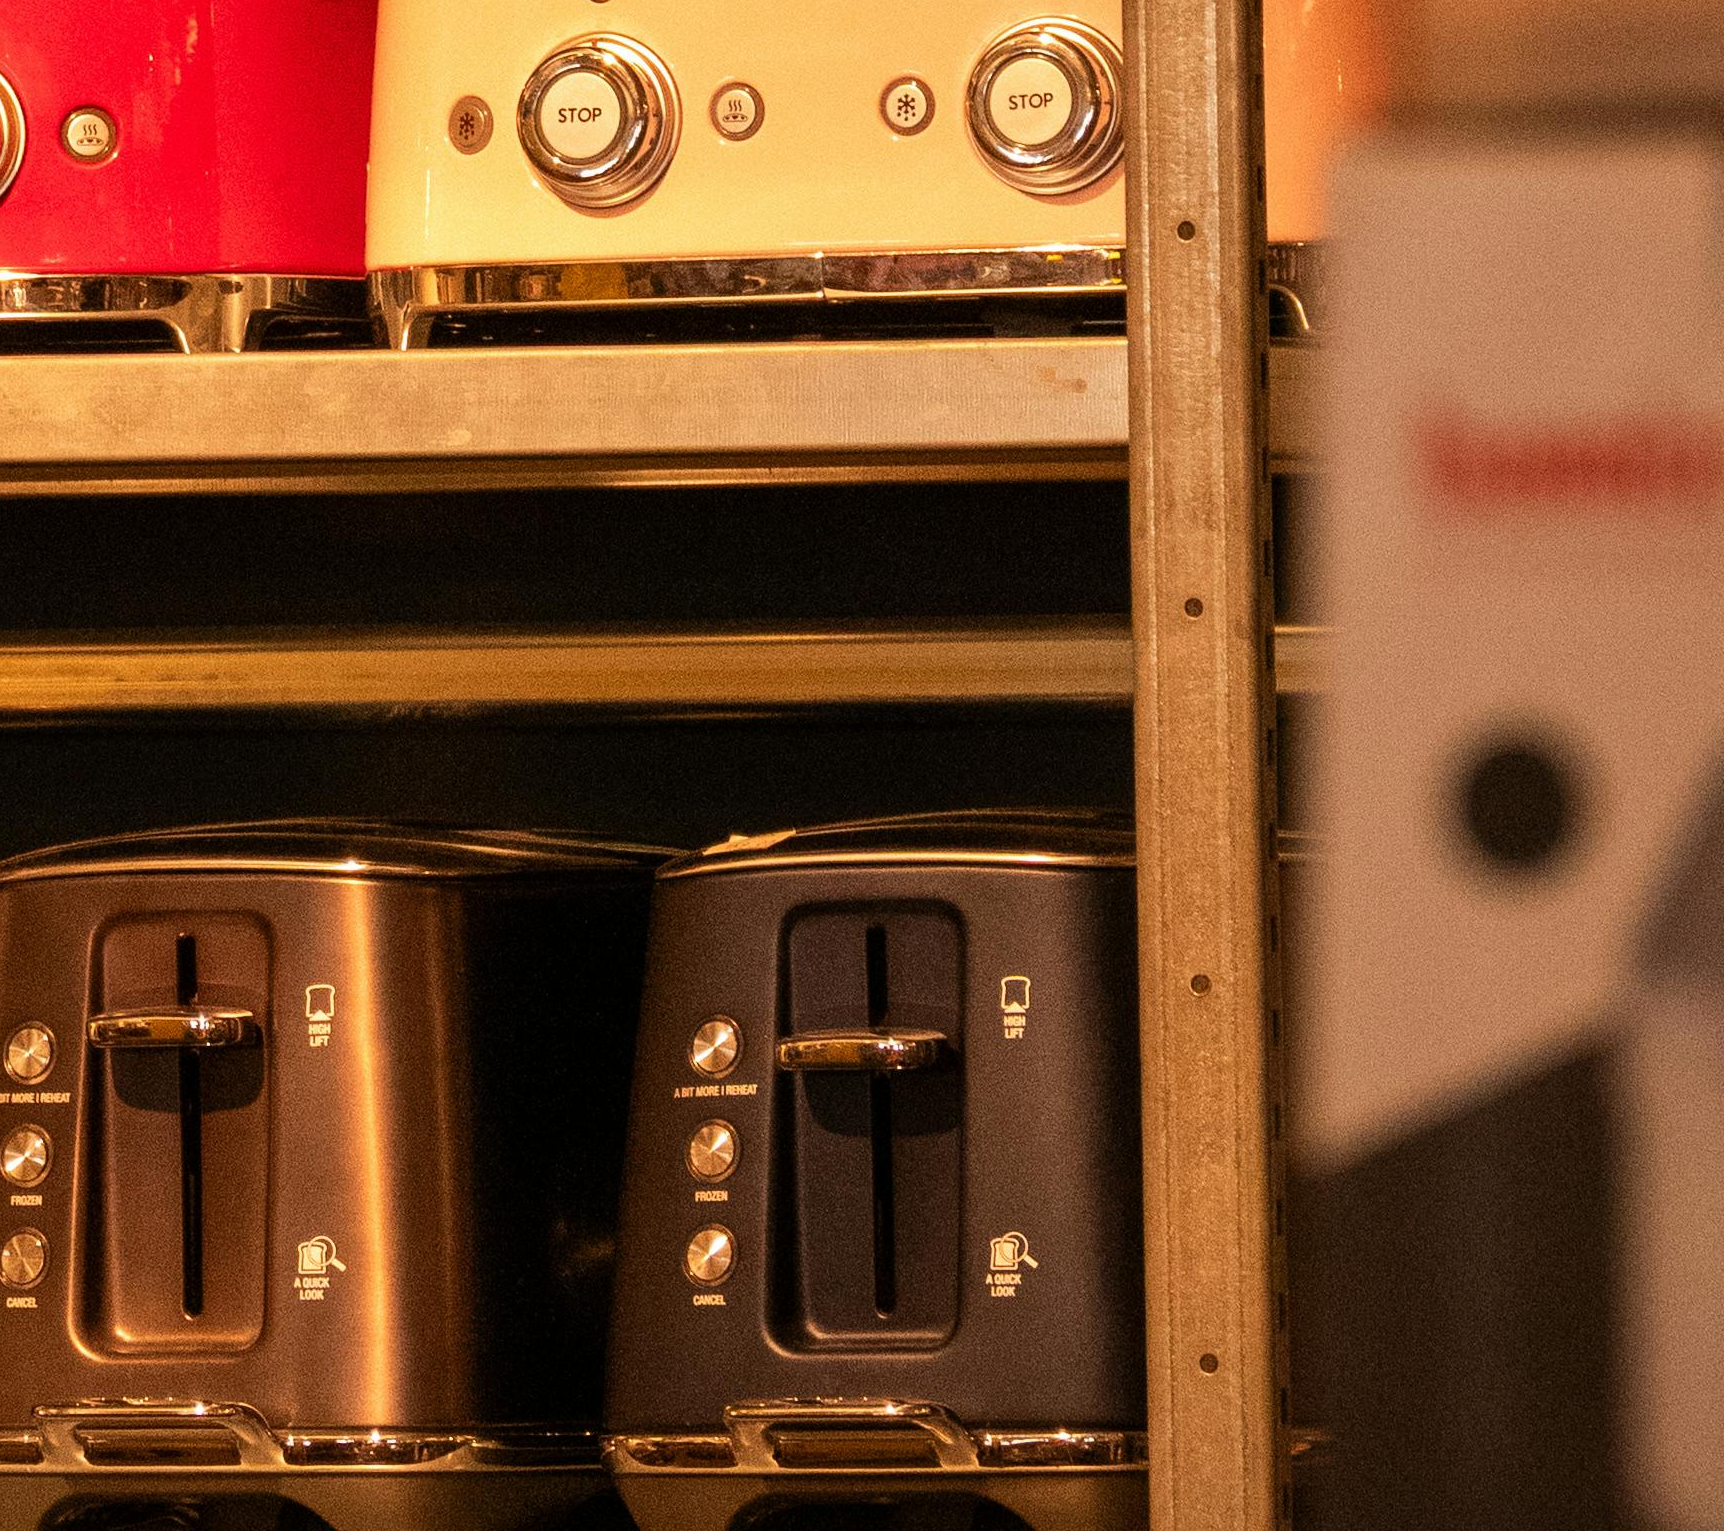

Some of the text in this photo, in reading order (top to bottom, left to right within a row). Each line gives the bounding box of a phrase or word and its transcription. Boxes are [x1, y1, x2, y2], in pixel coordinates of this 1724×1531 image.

[1008, 93, 1053, 110] STOP
[558, 107, 602, 123] STOP
[1003, 1015, 1026, 1027] HIGH
[308, 1023, 332, 1035] HIGH
[1005, 1027, 1024, 1039] LIFT
[310, 1035, 329, 1047] LIFT
[696, 1085, 720, 1097] MORE
[726, 1084, 758, 1095] REHEAT
[11, 1092, 35, 1104] MORE
[40, 1092, 71, 1103] REHEAT
[11, 1195, 42, 1206] FROZEN
[695, 1191, 728, 1202] FROZEN
[294, 1277, 331, 1289] A QUICK
[986, 1274, 1022, 1285] A QUICK
[300, 1289, 325, 1300] LOOK
[991, 1286, 1016, 1297] LOOK
[6, 1297, 38, 1308] CANCEL
[693, 1295, 726, 1306] CANCEL
